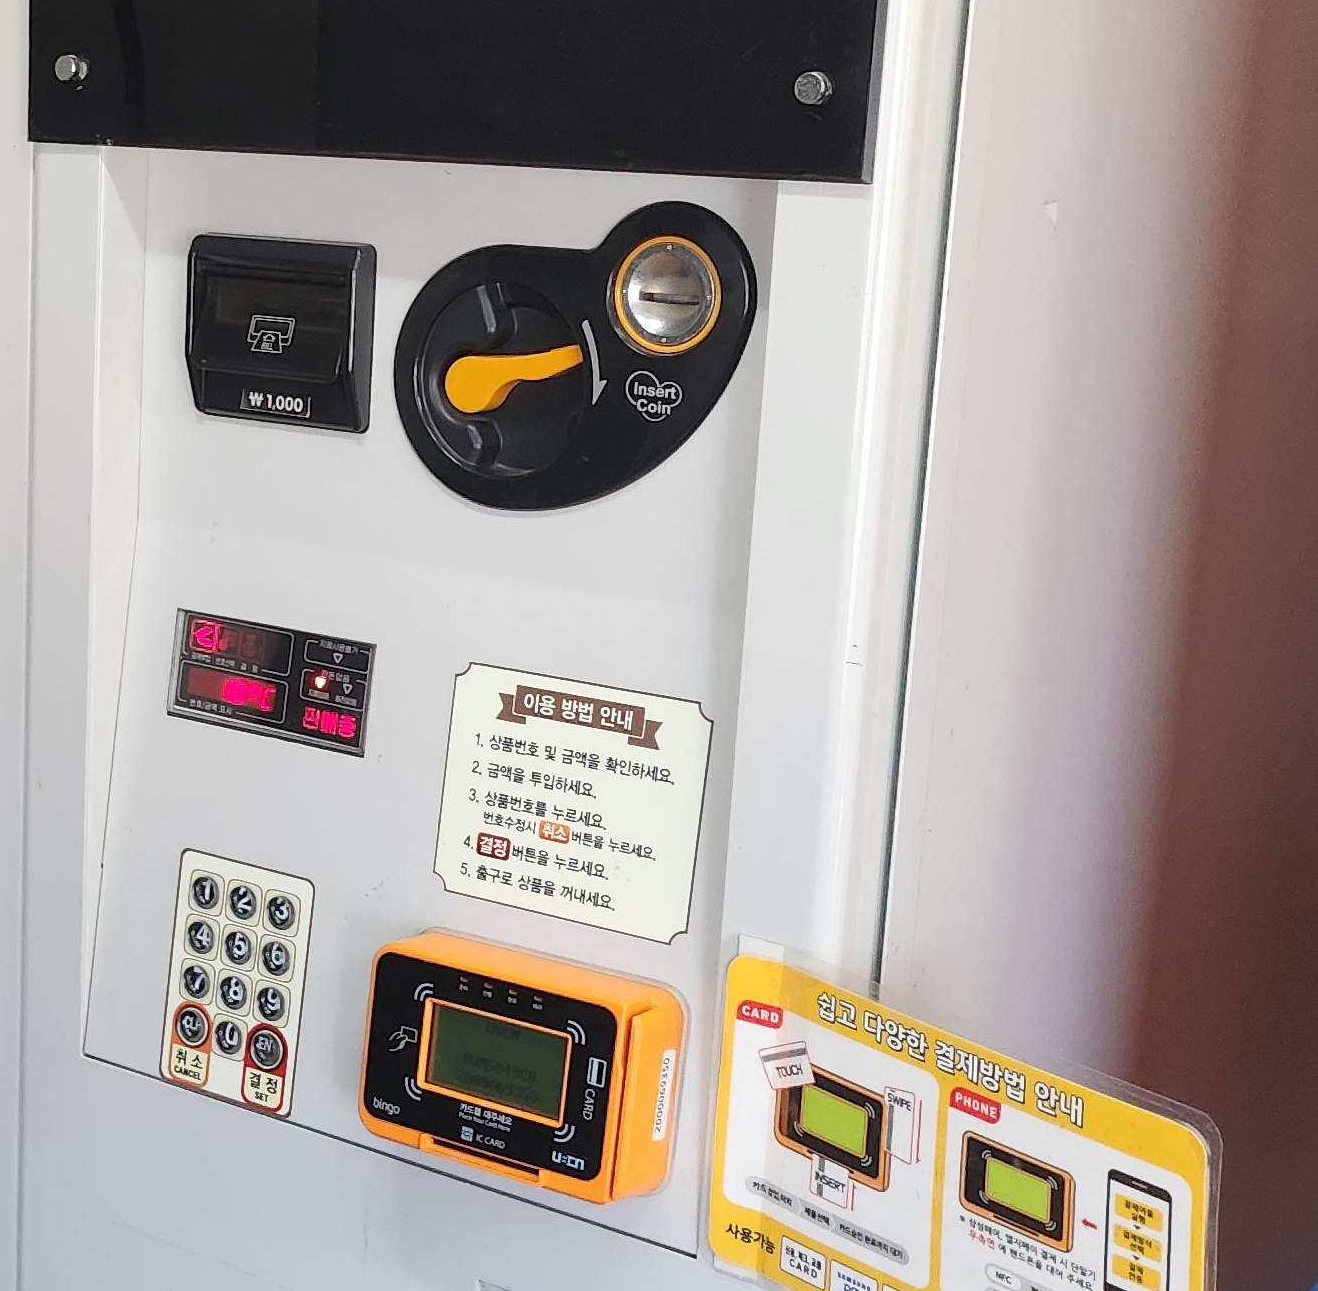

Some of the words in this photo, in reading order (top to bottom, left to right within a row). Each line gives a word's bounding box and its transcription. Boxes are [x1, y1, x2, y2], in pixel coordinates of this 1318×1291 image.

[633, 381, 677, 400] Insert
[636, 398, 671, 416] Coin
[523, 693, 556, 715] 이용
[561, 699, 594, 723] 방법
[600, 706, 633, 731] 안내
[475, 733, 484, 748] 1.
[489, 734, 539, 758] 상품번호
[544, 745, 557, 761] 및
[561, 749, 600, 770] 금액을
[605, 757, 675, 786] 확인하세요.
[471, 761, 482, 776] 2.
[487, 762, 525, 784] 금액을
[529, 771, 597, 799] 투입하세요.
[468, 789, 480, 804] 3.
[484, 790, 548, 817] 상품번호를
[551, 805, 607, 831] 누르세요.
[483, 811, 537, 835] 번호수정시
[541, 823, 570, 843] 취소
[571, 830, 604, 849] 버튼을
[607, 837, 657, 862] 누르세요.
[463, 835, 474, 850] 4.
[479, 836, 508, 858] 결정
[511, 845, 550, 867] 버튼을
[553, 854, 609, 881] 누르세요.
[460, 863, 471, 878] 5.
[475, 864, 513, 887] 출구로
[517, 875, 556, 898] 상품을
[560, 884, 615, 912] 꺼내세요.
[202, 880, 212, 902] 1
[237, 885, 254, 914] 2
[275, 897, 290, 921] 3
[195, 922, 211, 945] 4
[232, 931, 248, 955] 5
[271, 942, 286, 966] 6
[192, 965, 207, 990] 7
[229, 976, 244, 1001] 8
[266, 987, 281, 1011] 9
[741, 1004, 779, 1024] CARD
[175, 1048, 204, 1070] 취소
[775, 1063, 803, 1078] TOUCH
[816, 992, 857, 1030] 쉽고
[863, 1012, 929, 1062] 다양한
[934, 1039, 1026, 1104] 결제방법
[1034, 1081, 1084, 1128] 안내
[173, 1064, 202, 1081] CANCEL
[249, 1071, 279, 1096] 결정
[254, 1090, 270, 1104] SET
[372, 1096, 401, 1116] bingo
[582, 1088, 596, 1121] CARD
[887, 1092, 912, 1111] SWIPE
[954, 1091, 997, 1119] PHONE
[475, 1134, 483, 1144] IC
[484, 1137, 506, 1150] CARD
[815, 1171, 846, 1193] INSERT
[726, 1222, 776, 1255] 사용가능
[789, 1258, 818, 1279] CARD
[1041, 1249, 1057, 1265] 결제
[1060, 1257, 1068, 1269] 시
[995, 1270, 1012, 1285] NFC
